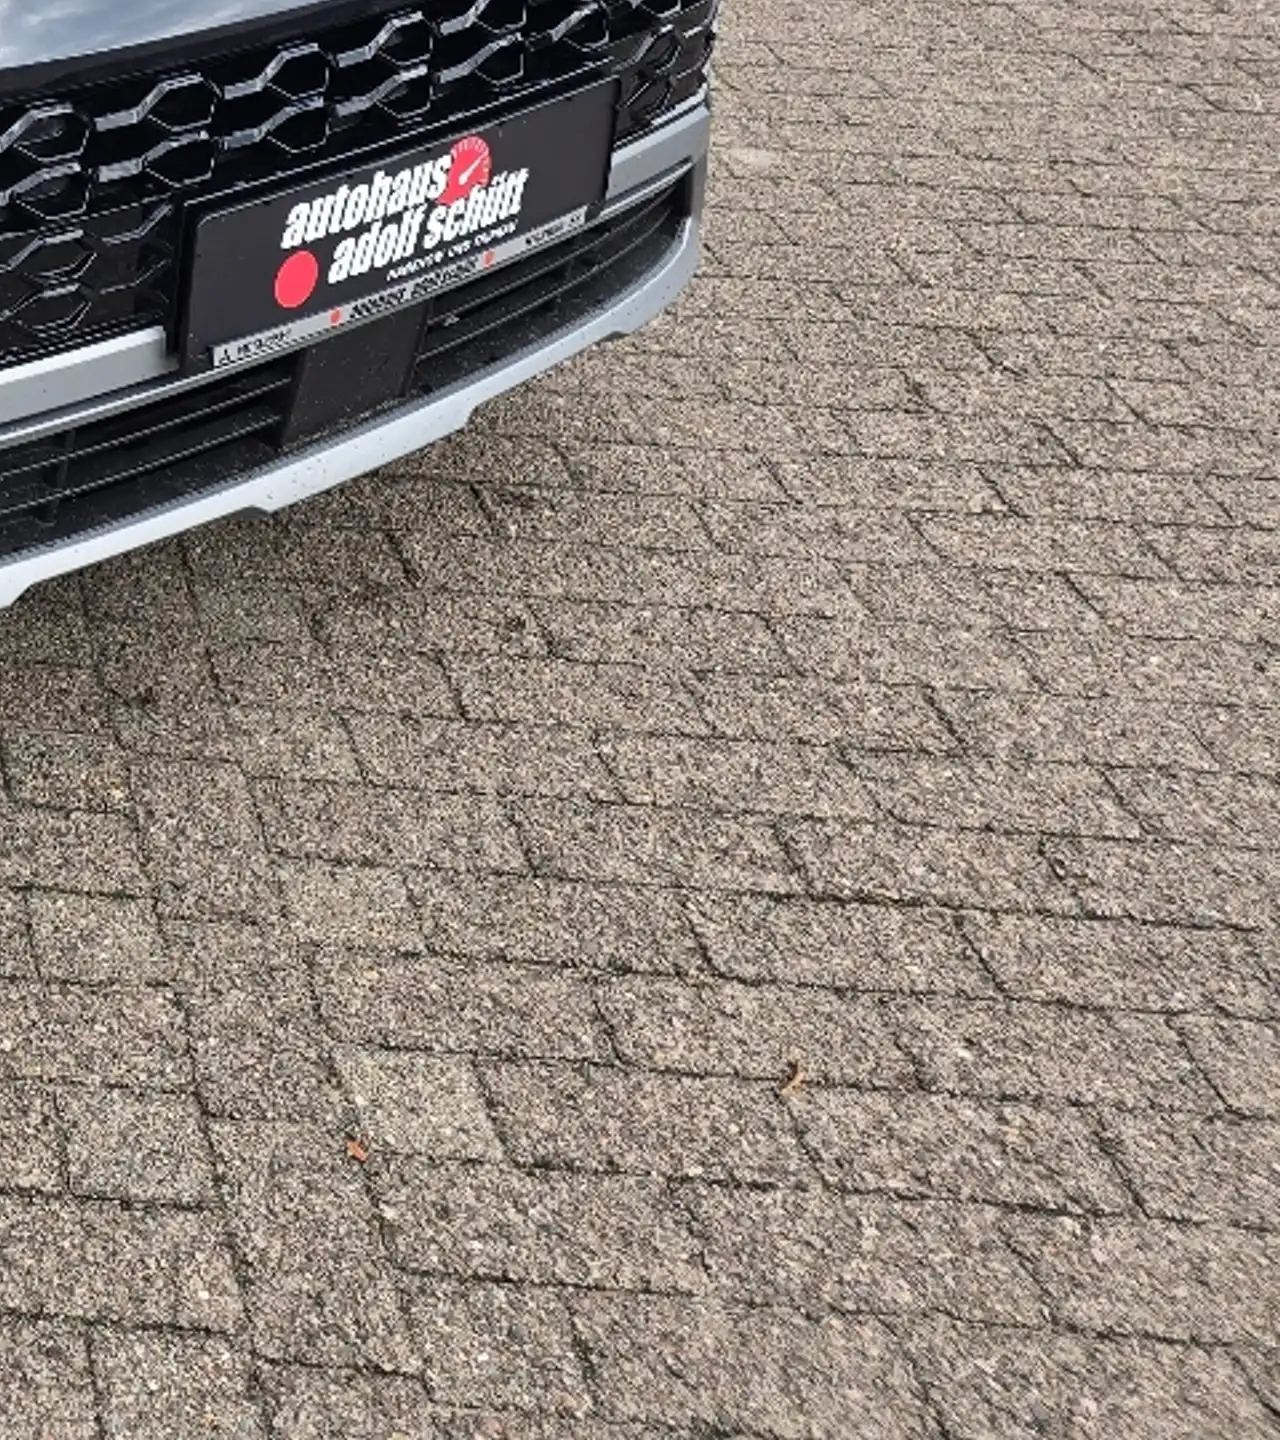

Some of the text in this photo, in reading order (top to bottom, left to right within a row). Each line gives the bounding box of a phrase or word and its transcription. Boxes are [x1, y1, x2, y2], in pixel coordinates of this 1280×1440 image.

[280, 155, 452, 249] autohaus
[327, 203, 430, 284] adolf
[422, 167, 529, 250] schütt
